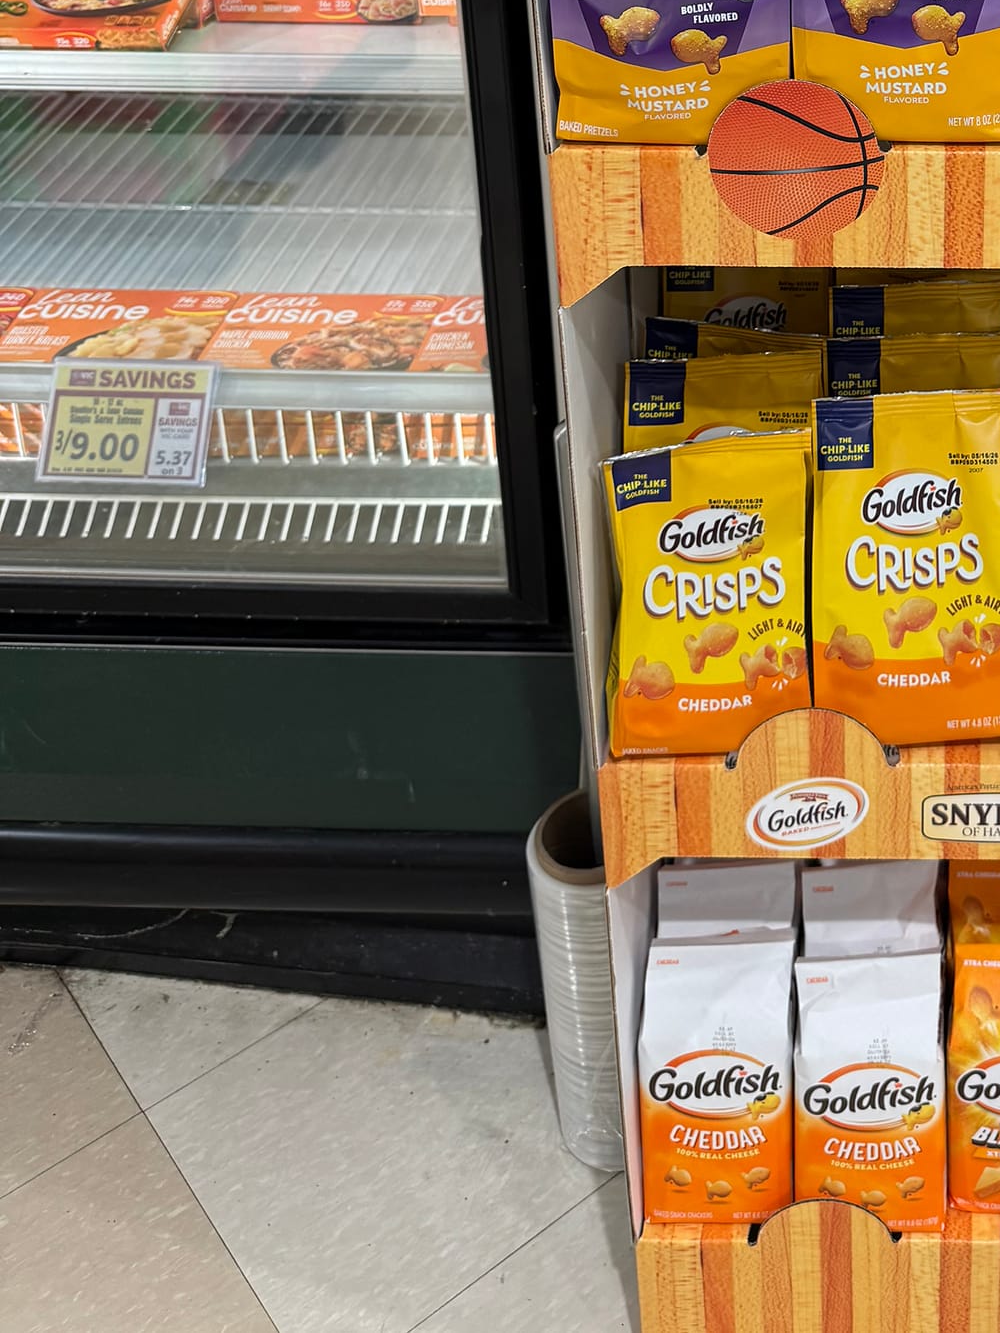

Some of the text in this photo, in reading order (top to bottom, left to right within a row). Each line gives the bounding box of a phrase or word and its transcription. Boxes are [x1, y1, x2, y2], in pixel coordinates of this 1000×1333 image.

[634, 82, 697, 97] HONEY
[627, 97, 709, 113] MUSTARD
[159, 417, 198, 427] SAVINGS
[155, 450, 191, 466] 5.37
[862, 478, 962, 525] Goldfish
[659, 514, 765, 554] Goldfish
[678, 694, 753, 713] CHEDDAR
[768, 801, 845, 832] Goldfish
[649, 1065, 779, 1105] Goldfish
[803, 1077, 934, 1117] Goldfish
[677, 1147, 760, 1160] 100% REAL CHEESE
